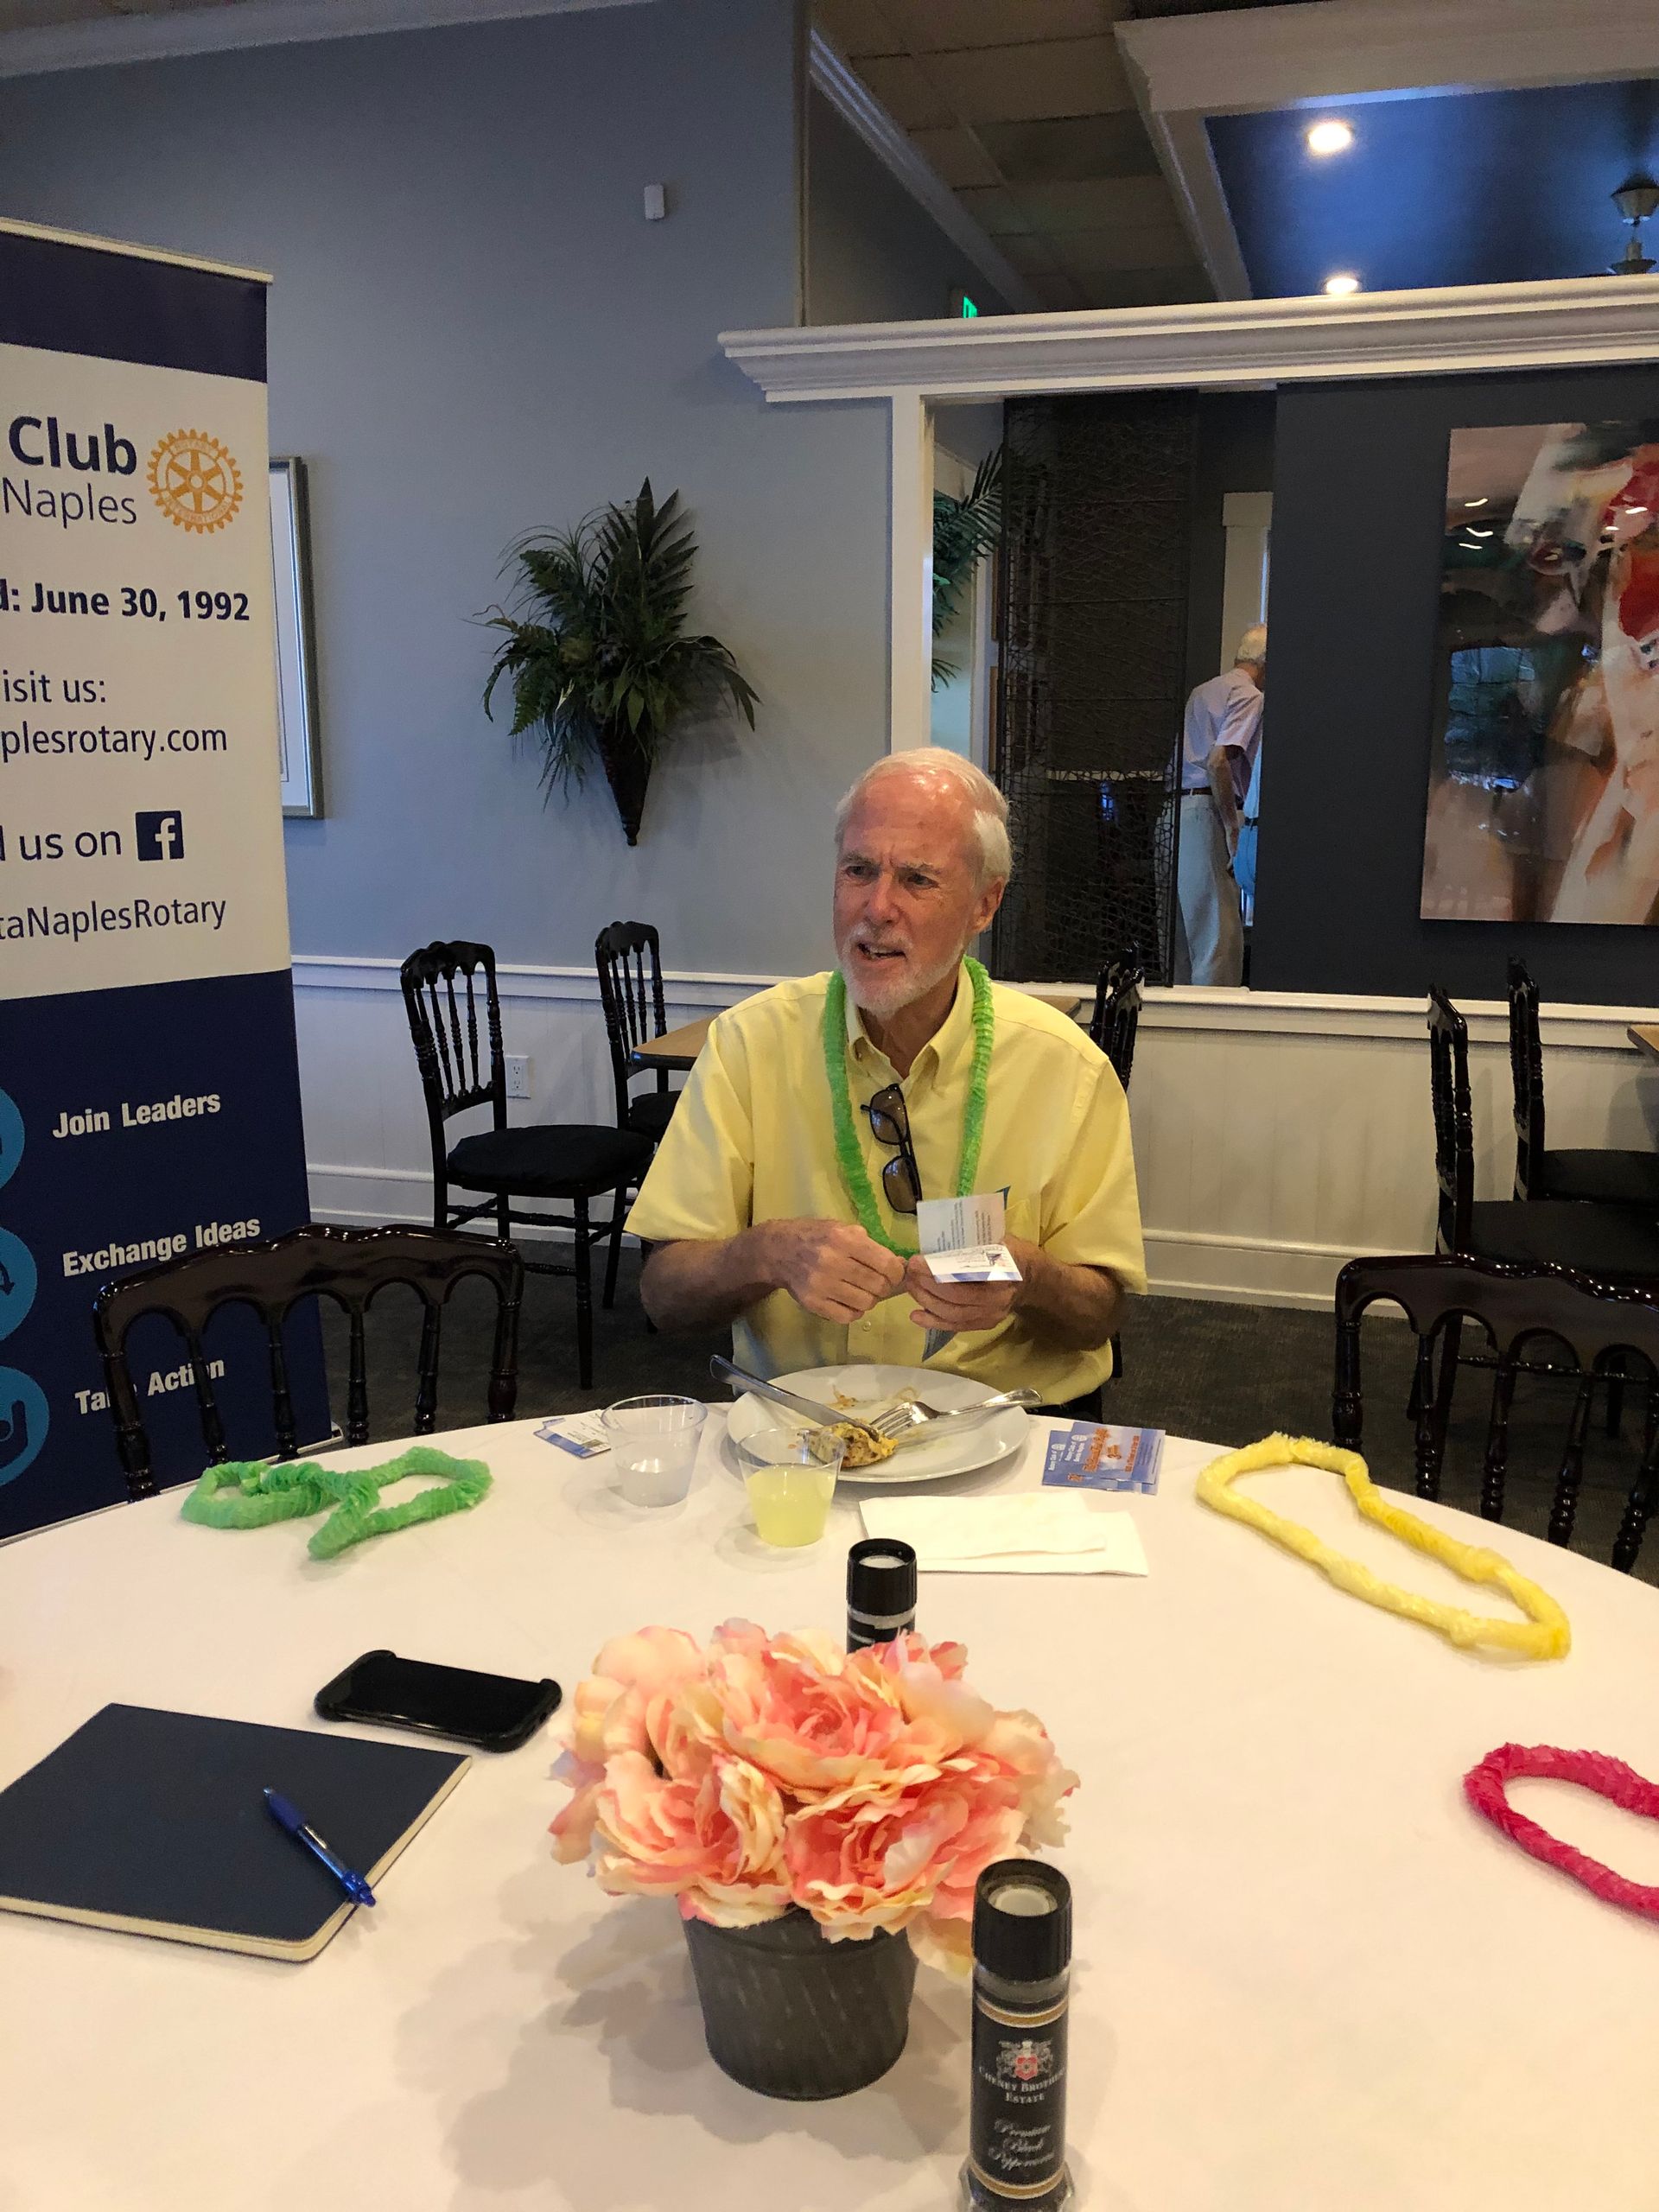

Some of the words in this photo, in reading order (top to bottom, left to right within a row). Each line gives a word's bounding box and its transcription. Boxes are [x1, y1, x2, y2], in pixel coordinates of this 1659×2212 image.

[10, 416, 137, 475] Club
[2, 477, 137, 529] Naples
[31, 582, 110, 615] June
[121, 587, 166, 621] 30,
[178, 590, 249, 620] 1992
[63, 679, 105, 703] us:
[1, 721, 227, 763] plesrotary.com
[20, 834, 63, 861] us
[75, 830, 121, 858] on
[53, 1109, 110, 1139] Join
[122, 1093, 221, 1128] Leaders
[63, 1233, 188, 1277] Exchange
[195, 1217, 260, 1249] Ideas
[74, 1383, 138, 1415] Ta
[147, 1359, 225, 1397] Actin
